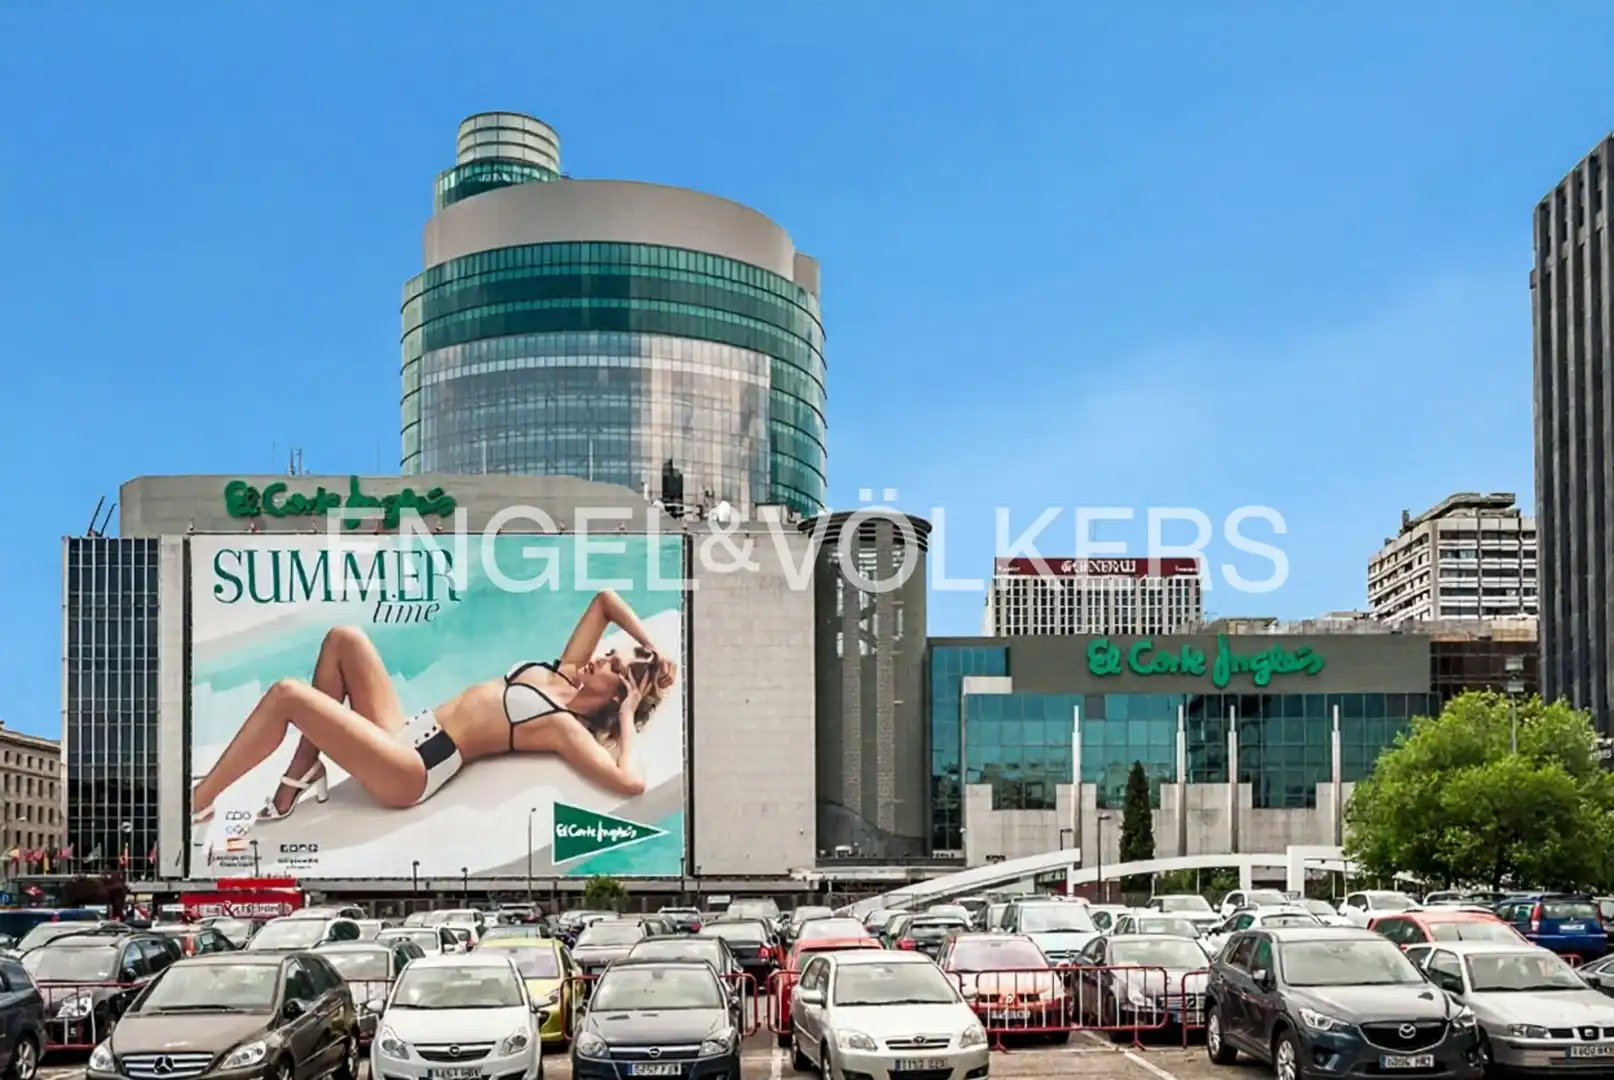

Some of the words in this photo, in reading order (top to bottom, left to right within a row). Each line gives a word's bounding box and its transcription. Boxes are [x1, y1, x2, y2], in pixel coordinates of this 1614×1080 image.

[213, 548, 461, 603] SUMMER
[373, 600, 440, 624] time
[1087, 637, 1122, 676] El
[1127, 638, 1207, 676] Corte
[555, 823, 568, 838] El
[568, 823, 596, 838] Corte
